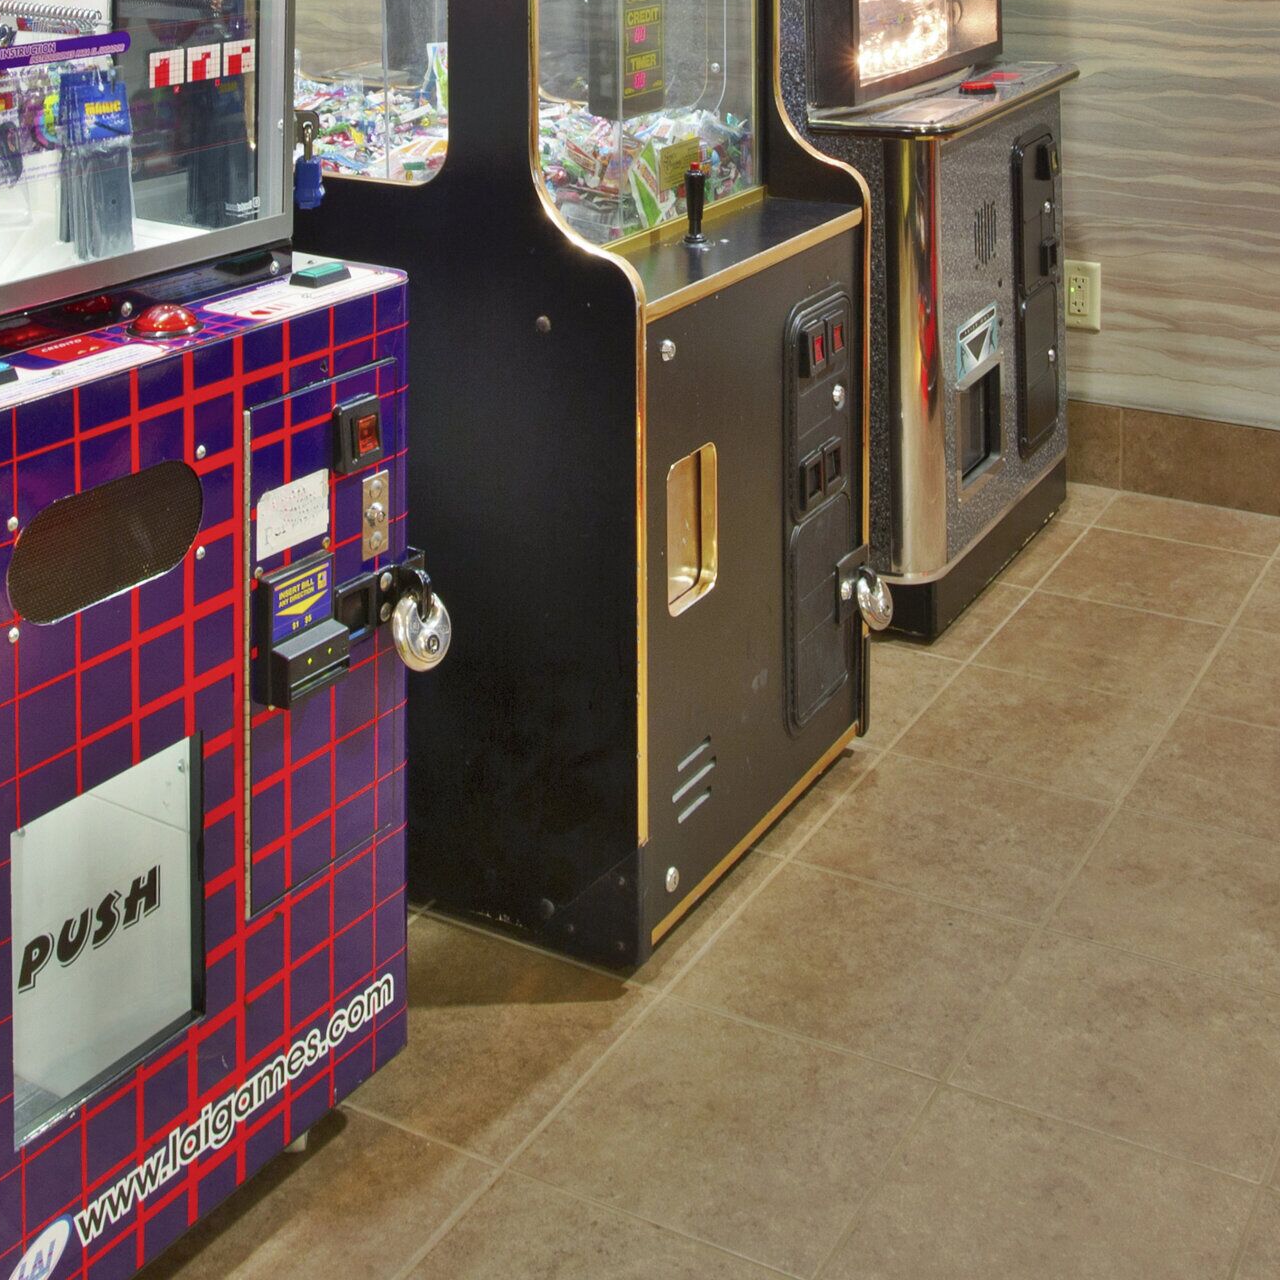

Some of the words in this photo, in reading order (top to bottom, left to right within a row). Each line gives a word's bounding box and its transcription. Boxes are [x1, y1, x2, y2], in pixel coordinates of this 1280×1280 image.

[627, 8, 660, 25] CREDIT
[0, 42, 57, 61] INSTRUCTION
[630, 53, 657, 70] TIMER
[278, 583, 300, 601] INSERT
[300, 578, 314, 592] BILL
[278, 597, 289, 608] ANY
[289, 587, 314, 604] DIRECTION
[17, 864, 162, 995] PUSH
[73, 972, 395, 1248] www.laigames.com
